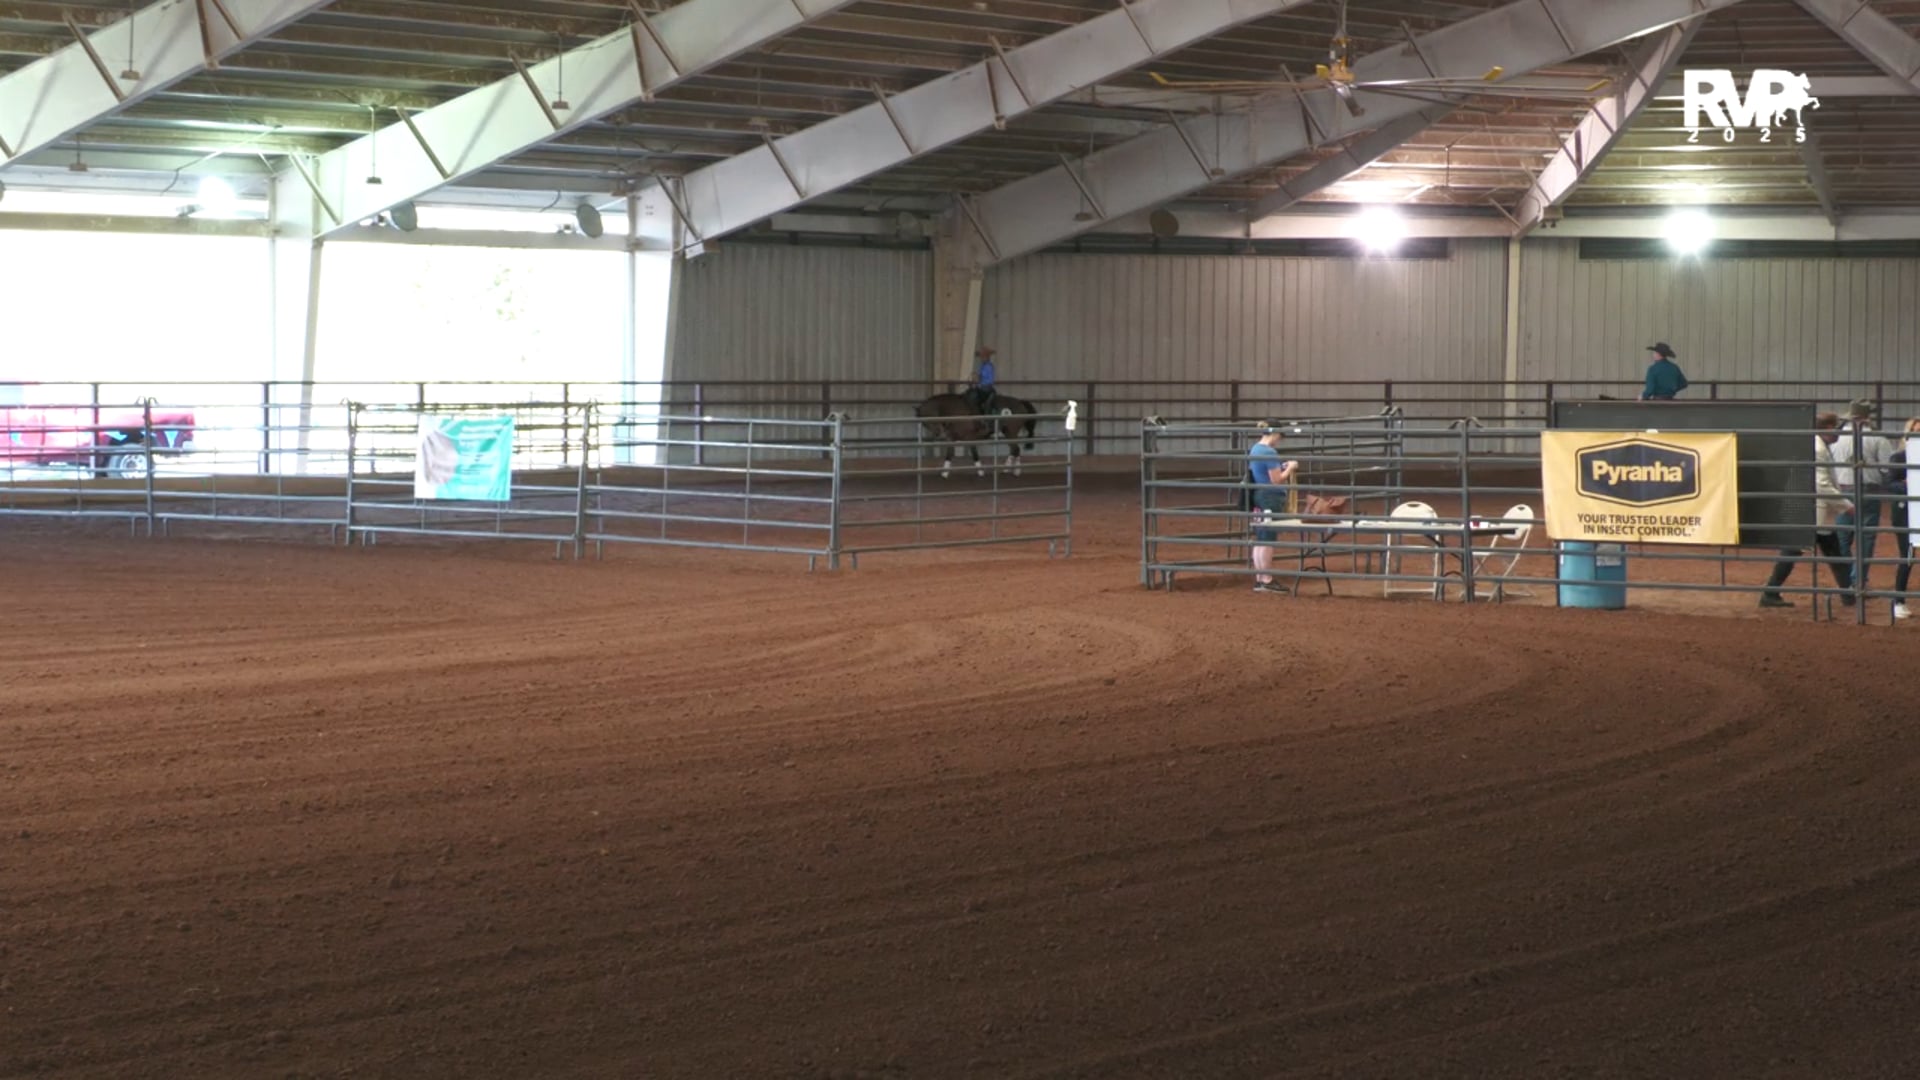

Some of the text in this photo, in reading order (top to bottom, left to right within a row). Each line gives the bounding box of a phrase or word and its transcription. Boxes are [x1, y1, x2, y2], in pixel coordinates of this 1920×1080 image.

[1592, 460, 1683, 486] Pyranha
[1577, 513, 1701, 527] YOUR TRUSTED LEADER
[1583, 524, 1692, 538] IN INSECT CONTROL.
